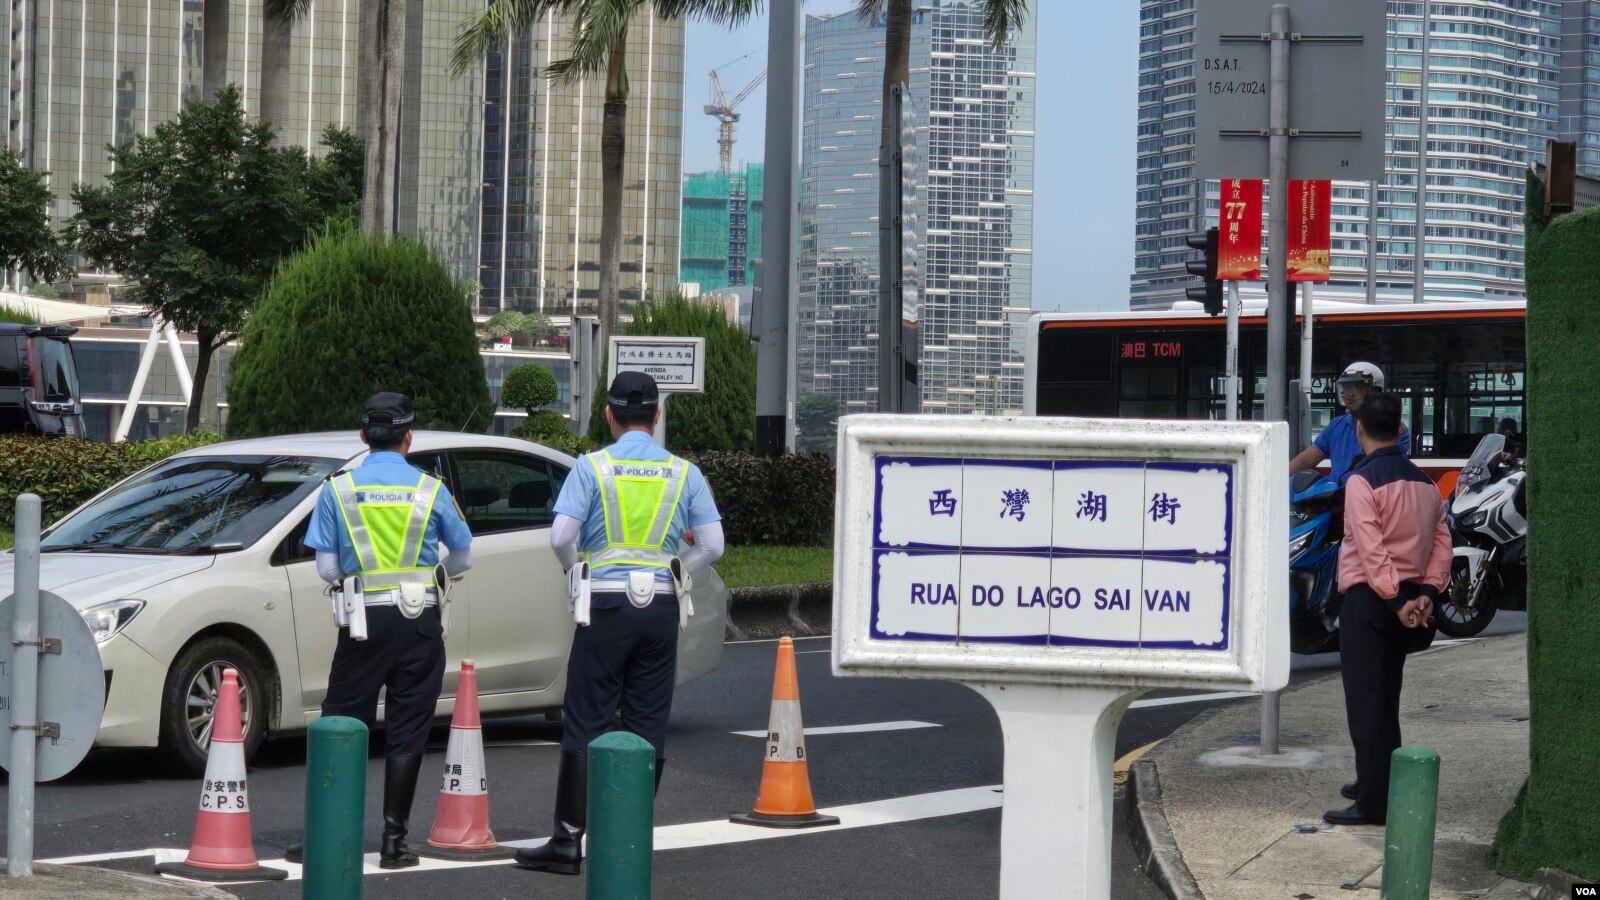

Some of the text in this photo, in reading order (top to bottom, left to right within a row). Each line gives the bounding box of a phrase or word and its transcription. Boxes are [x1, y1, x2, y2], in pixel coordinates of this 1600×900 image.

[1205, 59, 1241, 70] D.S.A.T.
[1207, 81, 1266, 95] 15/4/2024
[1302, 216, 1308, 224] da
[1121, 342, 1181, 358] 澳巴 TCM
[369, 492, 402, 501] POLÍCIA
[928, 488, 1182, 526] 西灣湖街
[910, 583, 1190, 612] RUA DO LAGO SAI VAN
